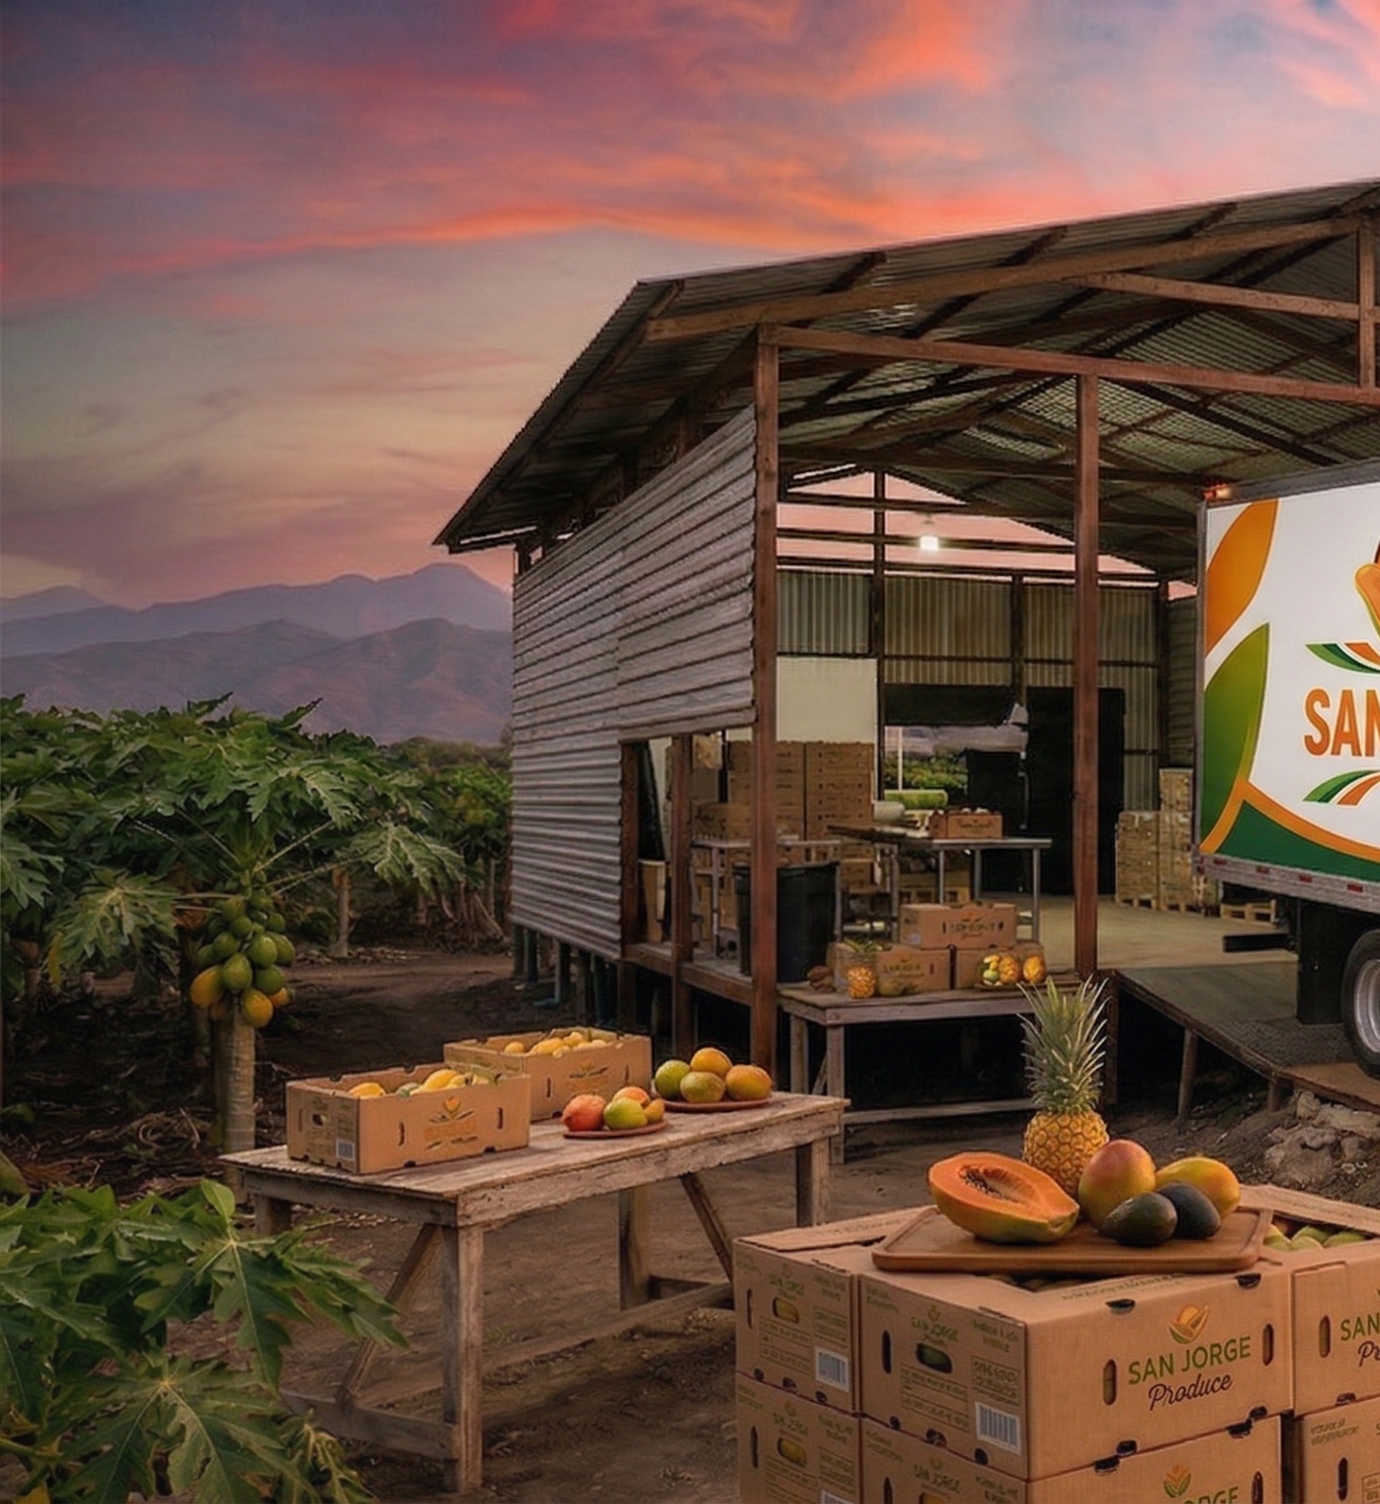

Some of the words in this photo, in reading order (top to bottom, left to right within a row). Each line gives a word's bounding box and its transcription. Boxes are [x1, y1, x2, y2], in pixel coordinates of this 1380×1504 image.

[1340, 1312, 1380, 1342] SAN
[1128, 1352, 1175, 1385] SAN
[1181, 1335, 1252, 1372] JORGE
[1148, 1373, 1233, 1412] Produce
